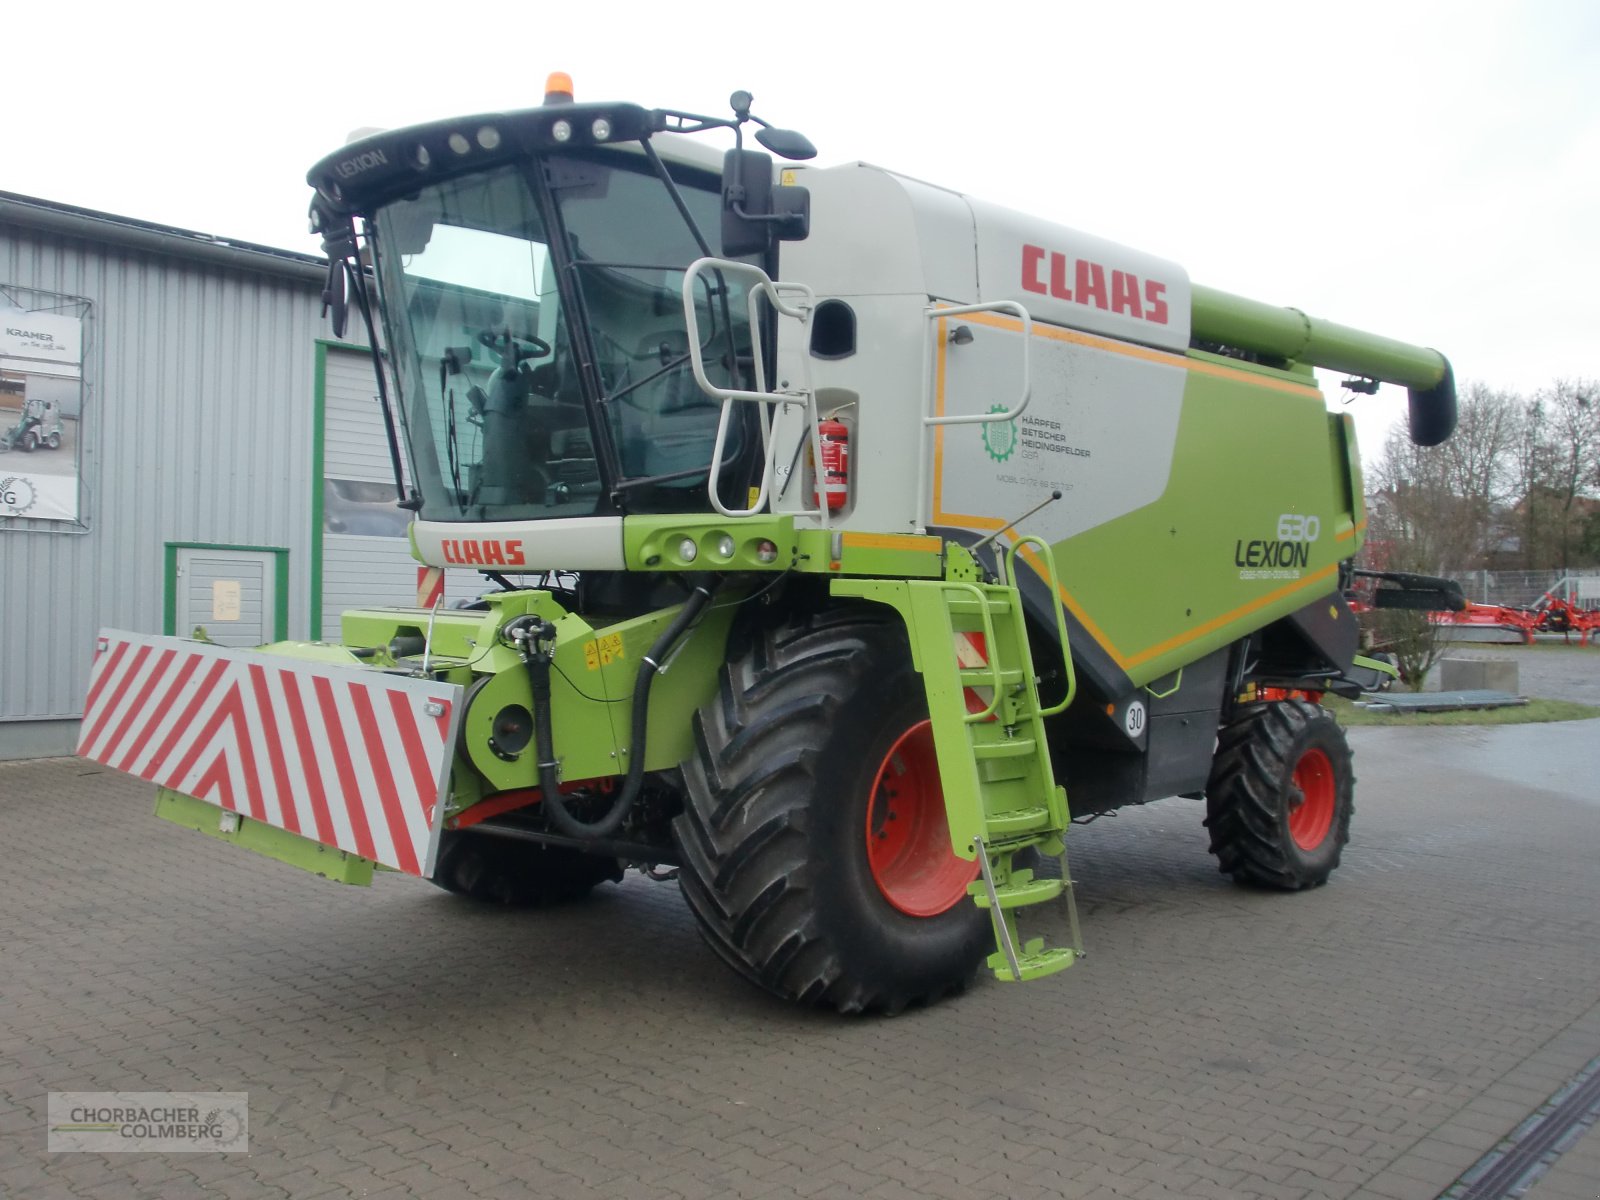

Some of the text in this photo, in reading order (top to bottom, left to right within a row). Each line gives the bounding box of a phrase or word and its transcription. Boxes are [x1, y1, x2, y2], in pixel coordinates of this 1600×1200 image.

[335, 149, 388, 178] LEXION
[1021, 243, 1169, 325] CLAAS
[6, 327, 54, 342] KRAMER
[1021, 416, 1061, 430] HÄRPFER
[1021, 427, 1066, 442] BETSCHER
[1021, 438, 1091, 458] HEIDINGSFELDER
[1277, 513, 1320, 542] 630
[441, 539, 526, 565] CLAAS
[1235, 540, 1310, 568] LEXION
[1129, 708, 1142, 730] 30
